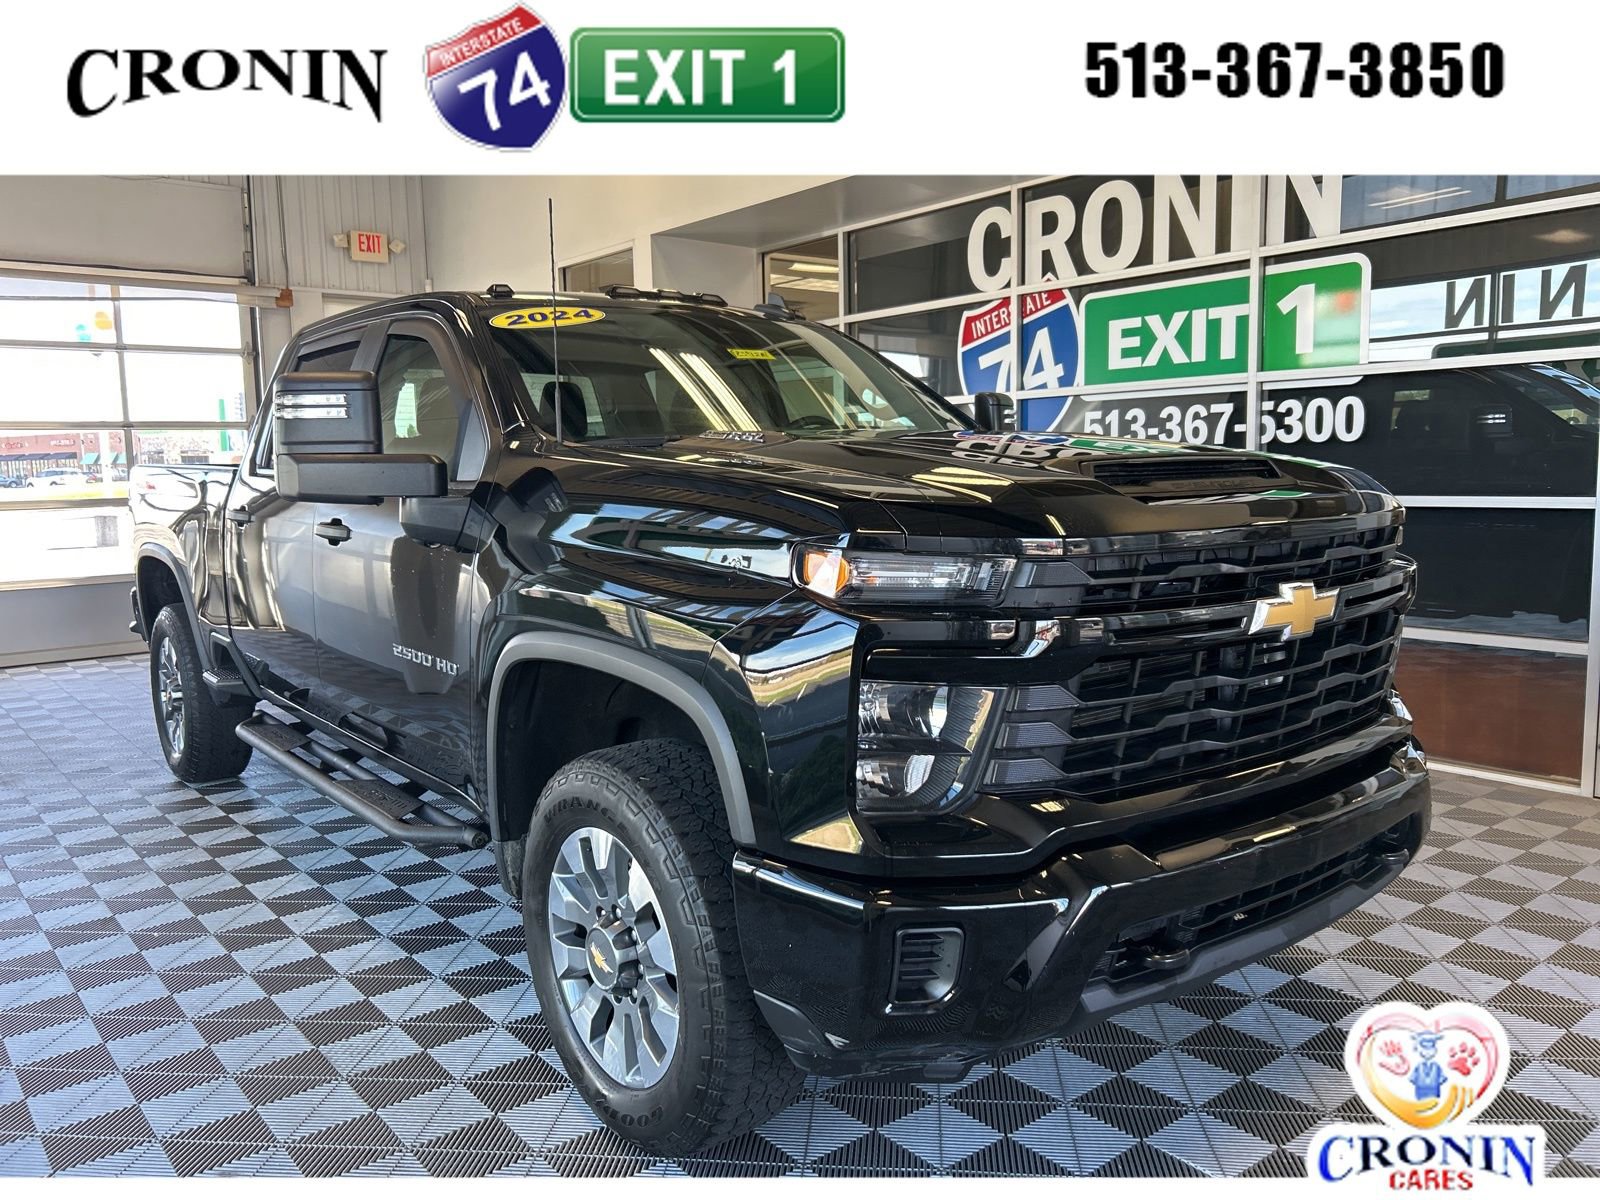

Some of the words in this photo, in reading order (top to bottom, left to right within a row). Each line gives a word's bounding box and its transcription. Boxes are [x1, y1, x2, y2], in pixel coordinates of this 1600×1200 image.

[357, 233, 382, 254] EXIT
[967, 175, 1342, 293] CRONIN
[504, 309, 594, 326] 2024
[971, 292, 1052, 340] INTERATE
[1107, 302, 1250, 371] EXIT
[1276, 283, 1316, 355] 1
[978, 326, 1065, 392] 74
[1083, 395, 1366, 446] 513-367-5300
[392, 642, 432, 668] 2500
[436, 657, 457, 677] HD
